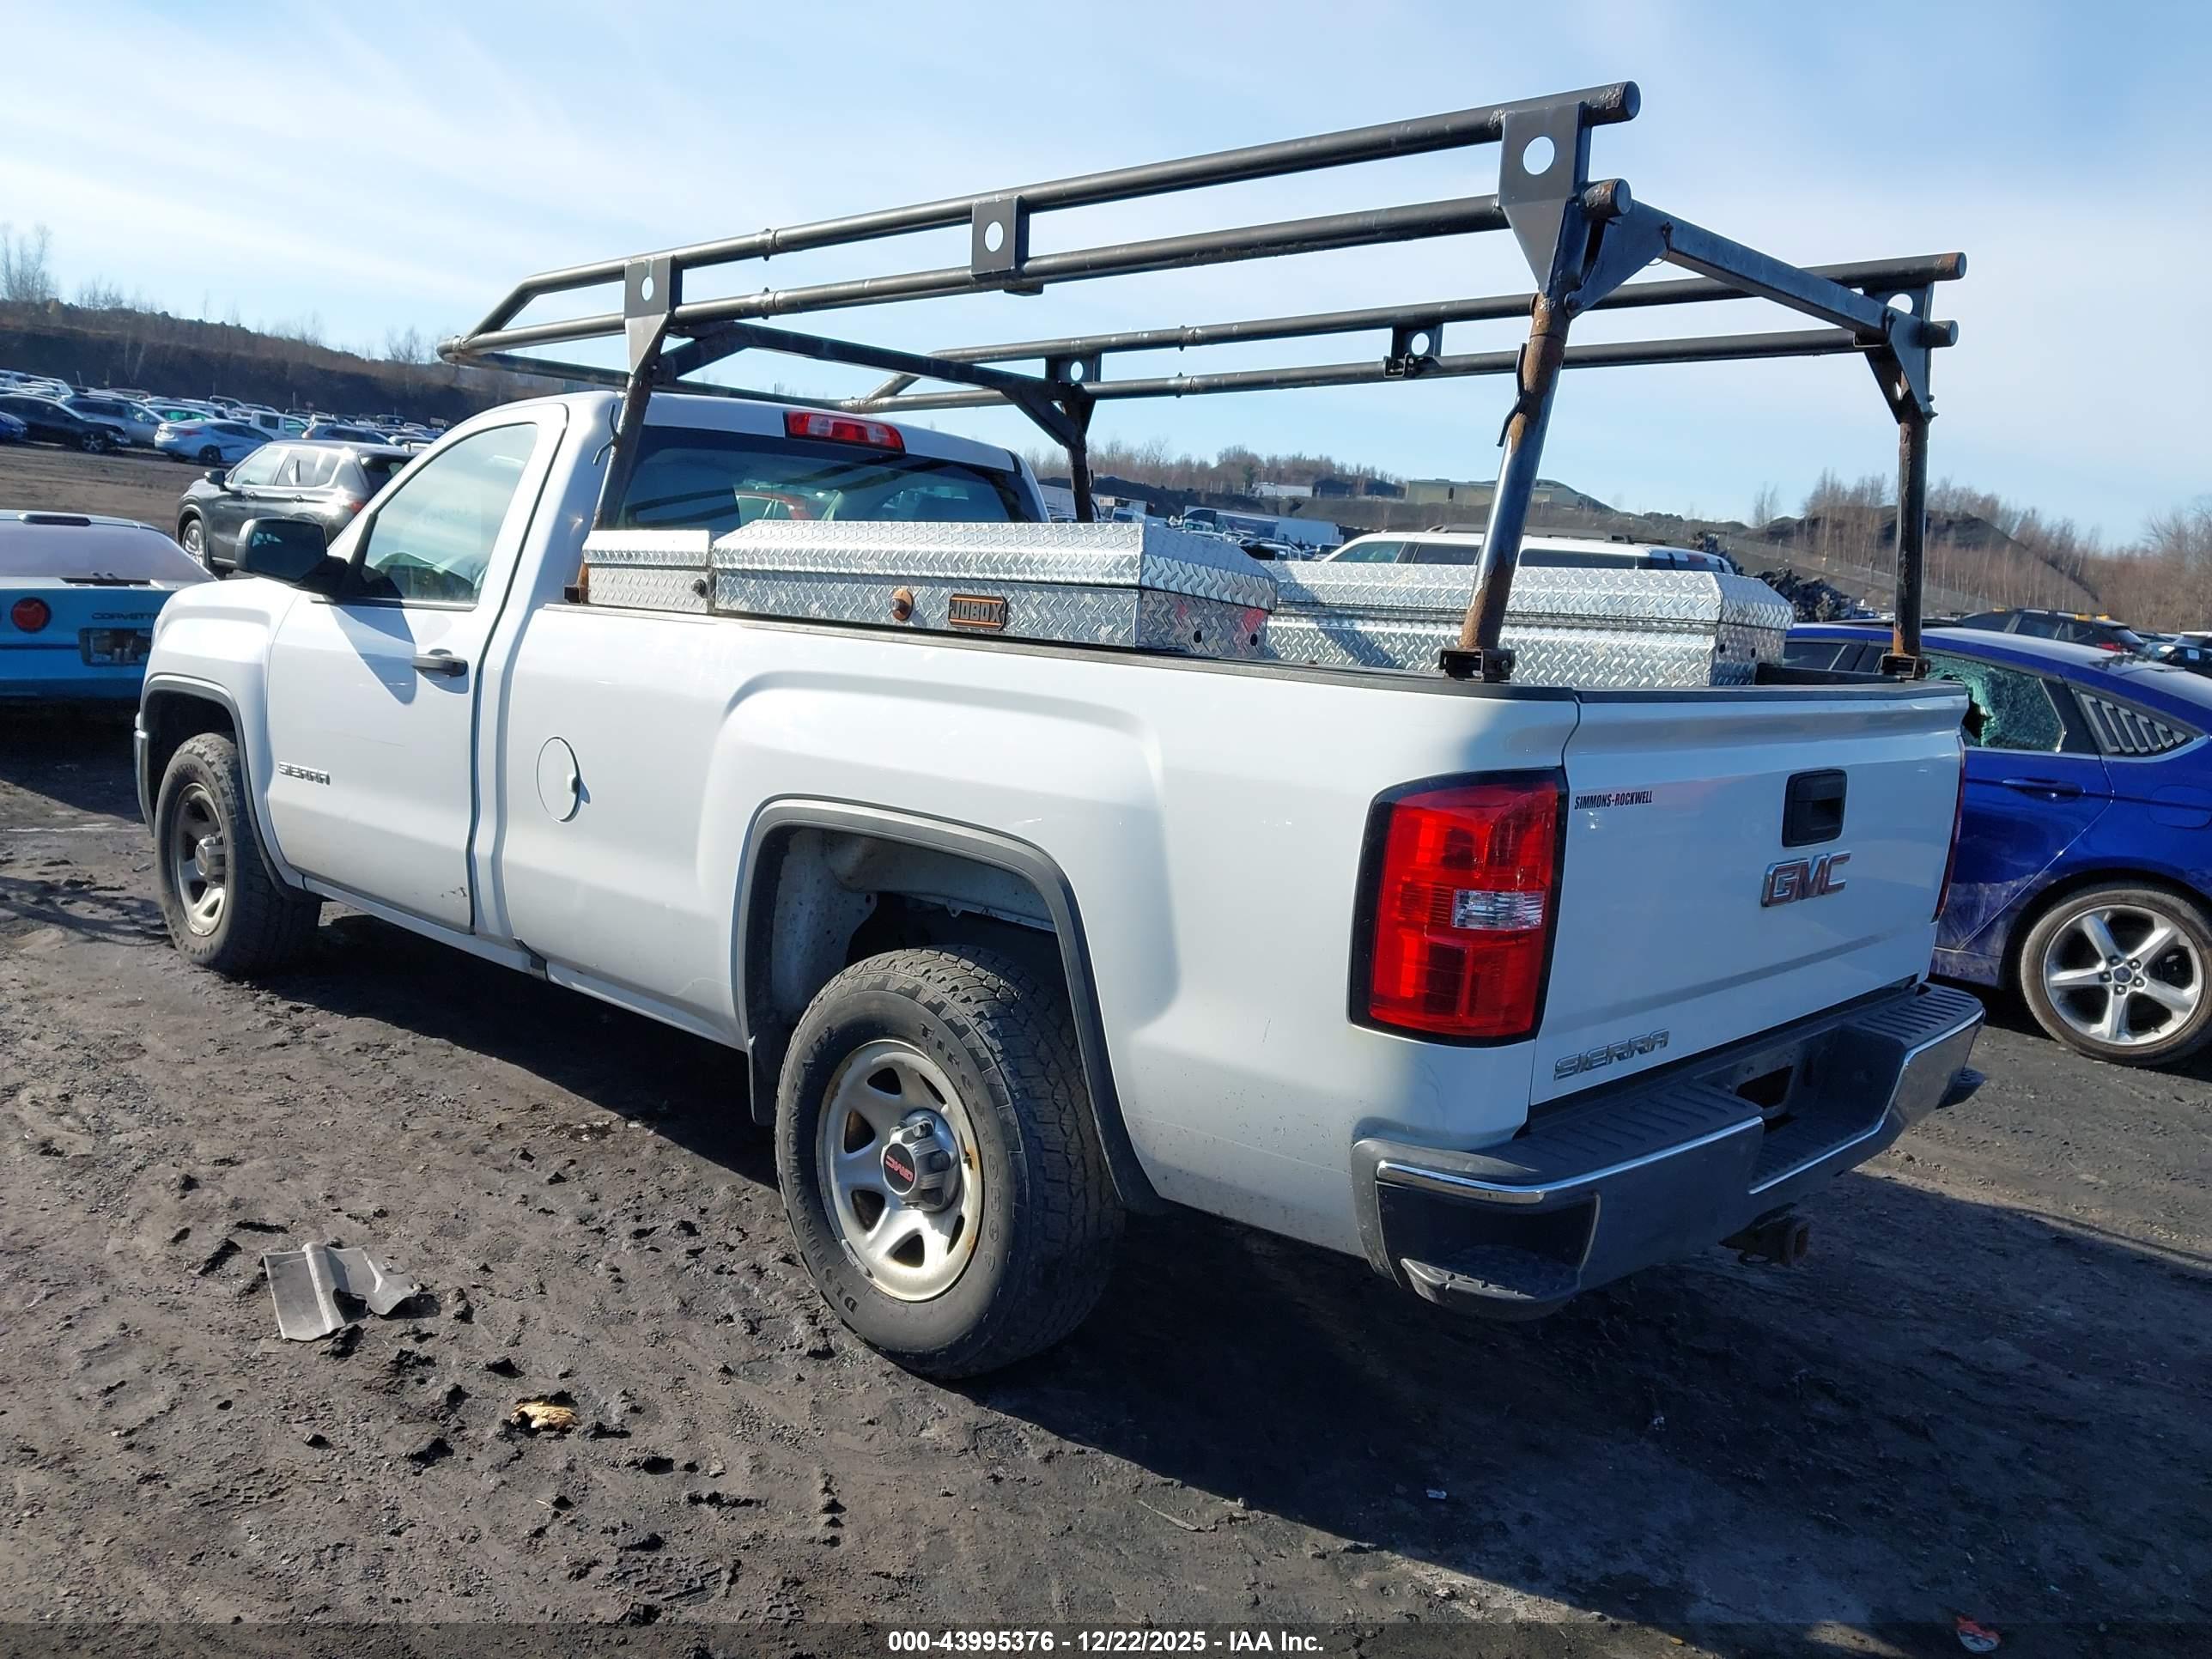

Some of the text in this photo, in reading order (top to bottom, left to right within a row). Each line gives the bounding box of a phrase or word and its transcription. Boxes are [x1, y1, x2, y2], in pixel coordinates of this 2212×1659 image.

[950, 599, 1004, 623] JOBOX
[278, 763, 330, 785] SIERRA
[1574, 790, 1653, 810] SIMMONS-ROCKWELL
[1761, 851, 1852, 907] GMC
[1553, 1028, 1669, 1081] SIERRA
[885, 1154, 914, 1182] GMC
